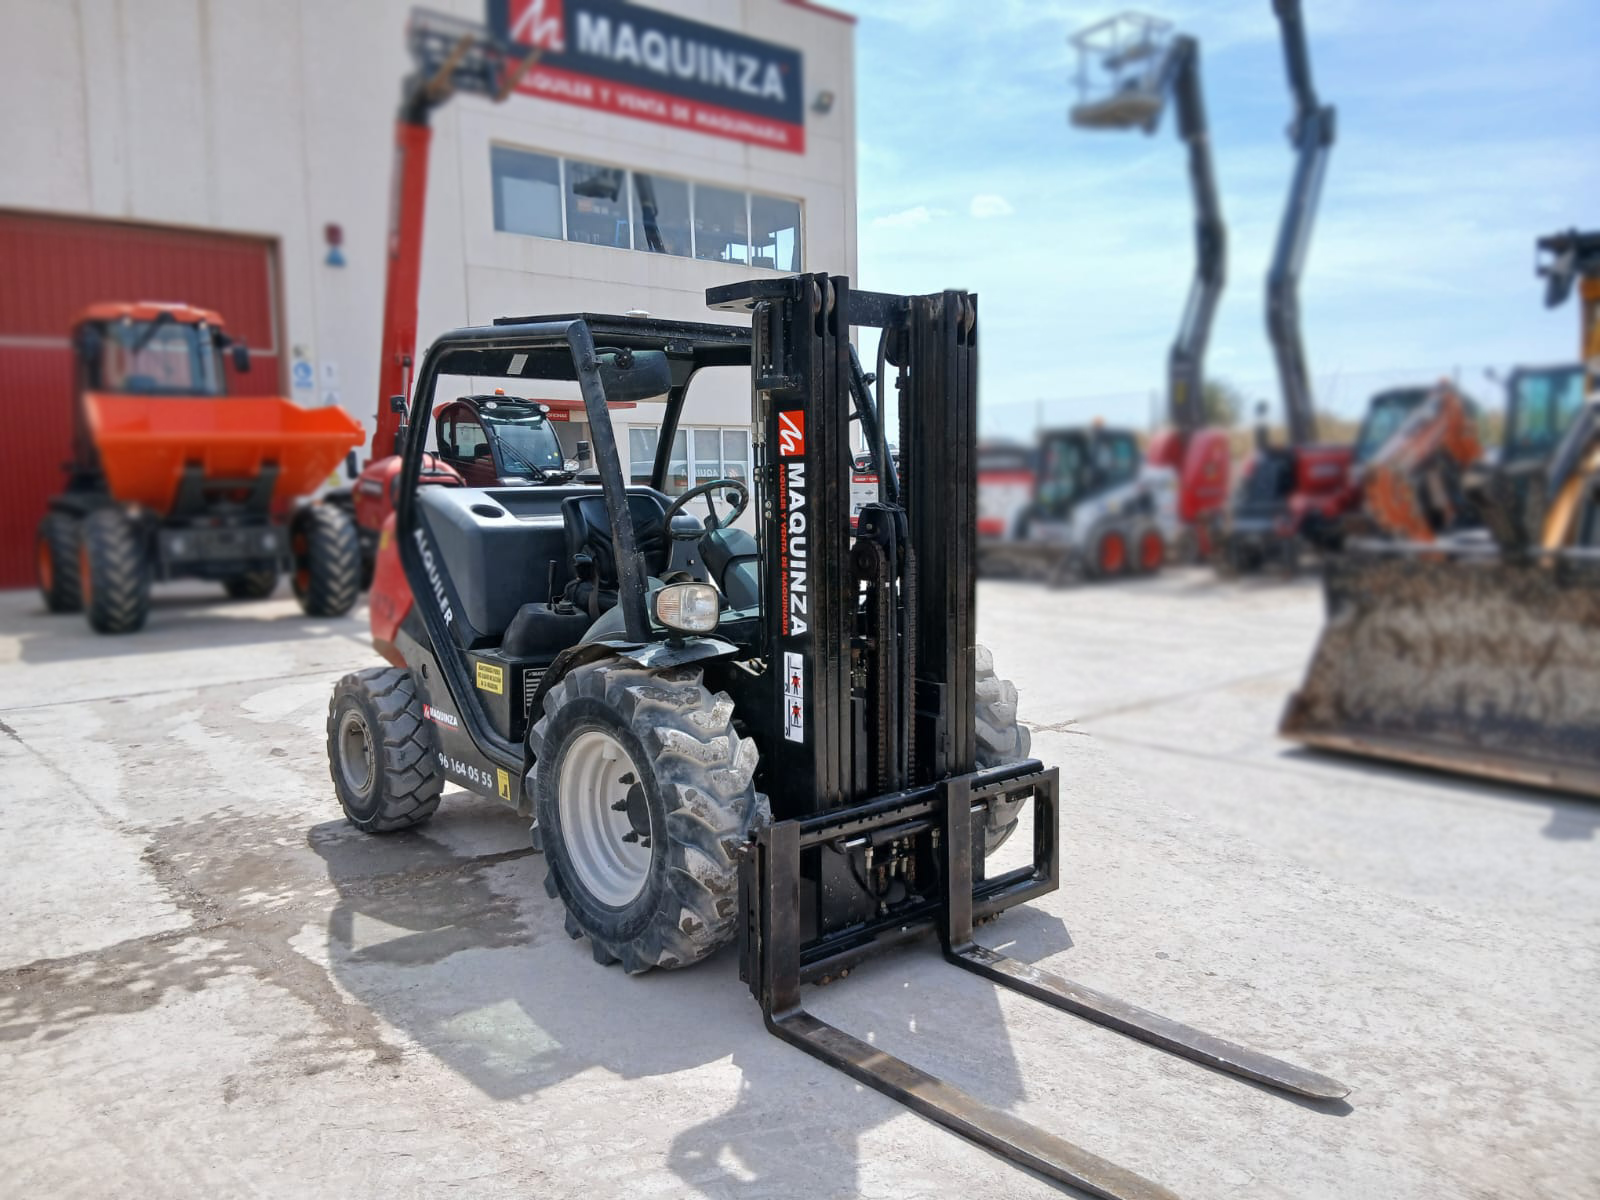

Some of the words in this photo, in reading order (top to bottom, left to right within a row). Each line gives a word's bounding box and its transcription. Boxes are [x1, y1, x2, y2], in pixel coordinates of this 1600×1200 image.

[519, 71, 594, 99] LQUILER
[576, 12, 785, 101] MAQUINZA
[414, 528, 453, 627] ALQUILER
[788, 463, 807, 636] MAQUINZA
[430, 706, 458, 726] MAQUINZA
[438, 753, 449, 768] 96
[451, 758, 466, 777] 164
[468, 766, 479, 782] 05
[482, 772, 492, 788] 55
